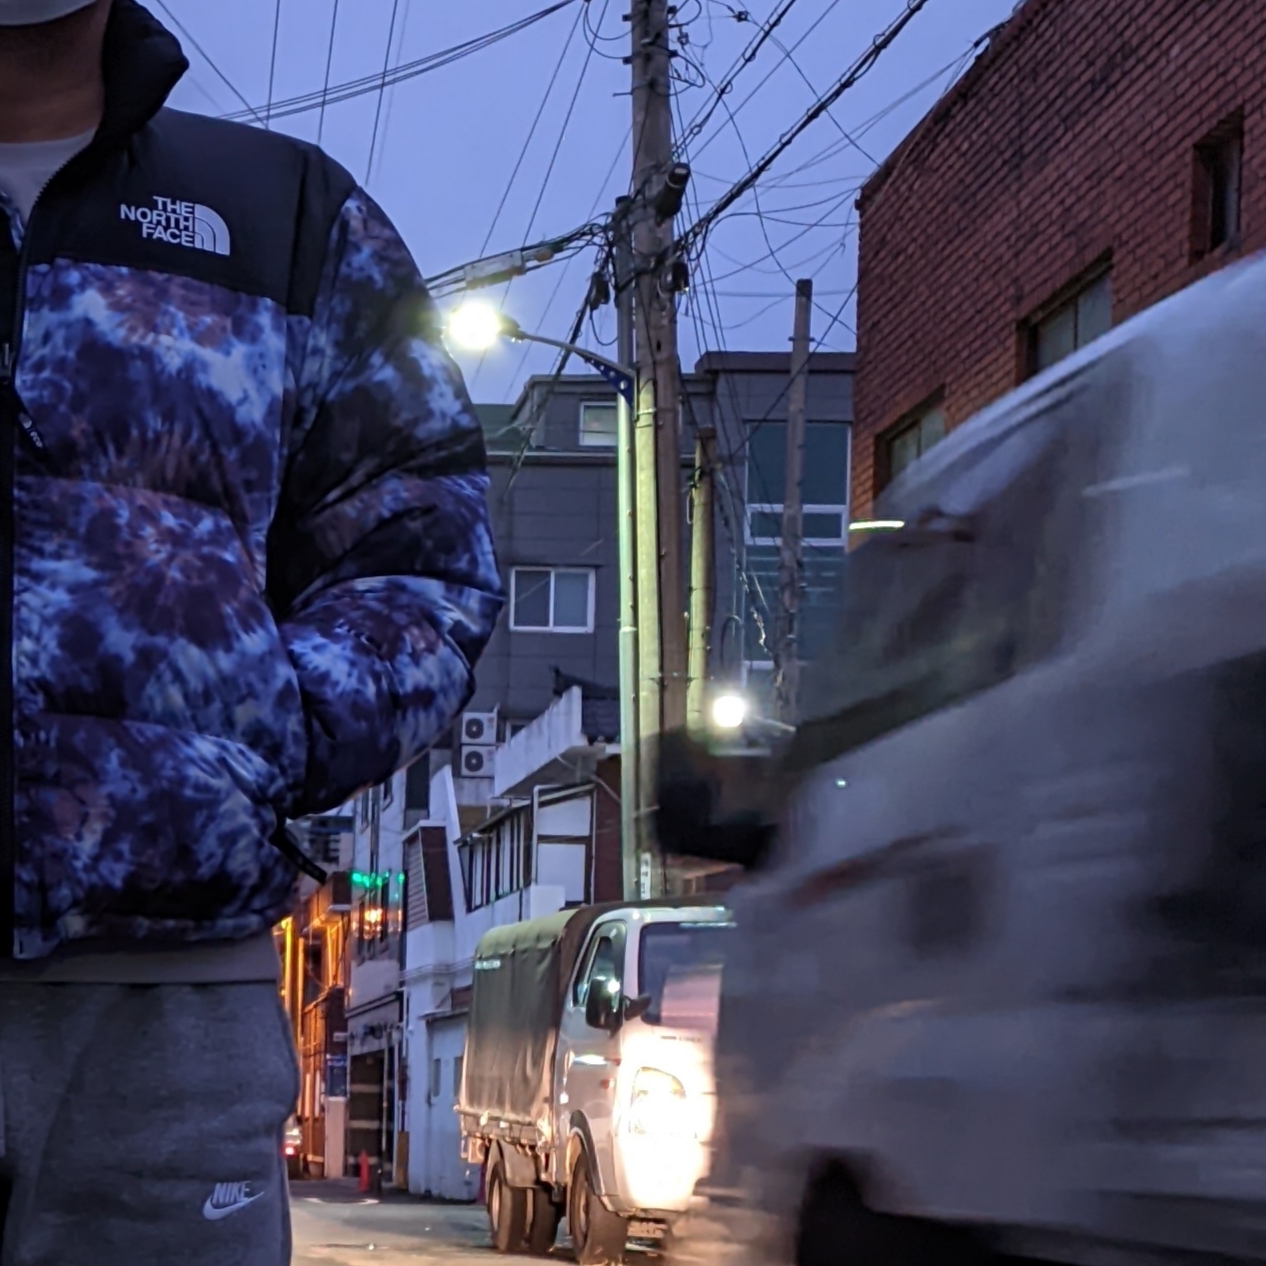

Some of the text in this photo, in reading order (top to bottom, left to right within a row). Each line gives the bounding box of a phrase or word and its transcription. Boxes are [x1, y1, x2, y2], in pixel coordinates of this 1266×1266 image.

[120, 203, 194, 232] NORTH
[152, 195, 194, 217] THE
[142, 223, 194, 247] FACE
[212, 1180, 252, 1204] NIKE
